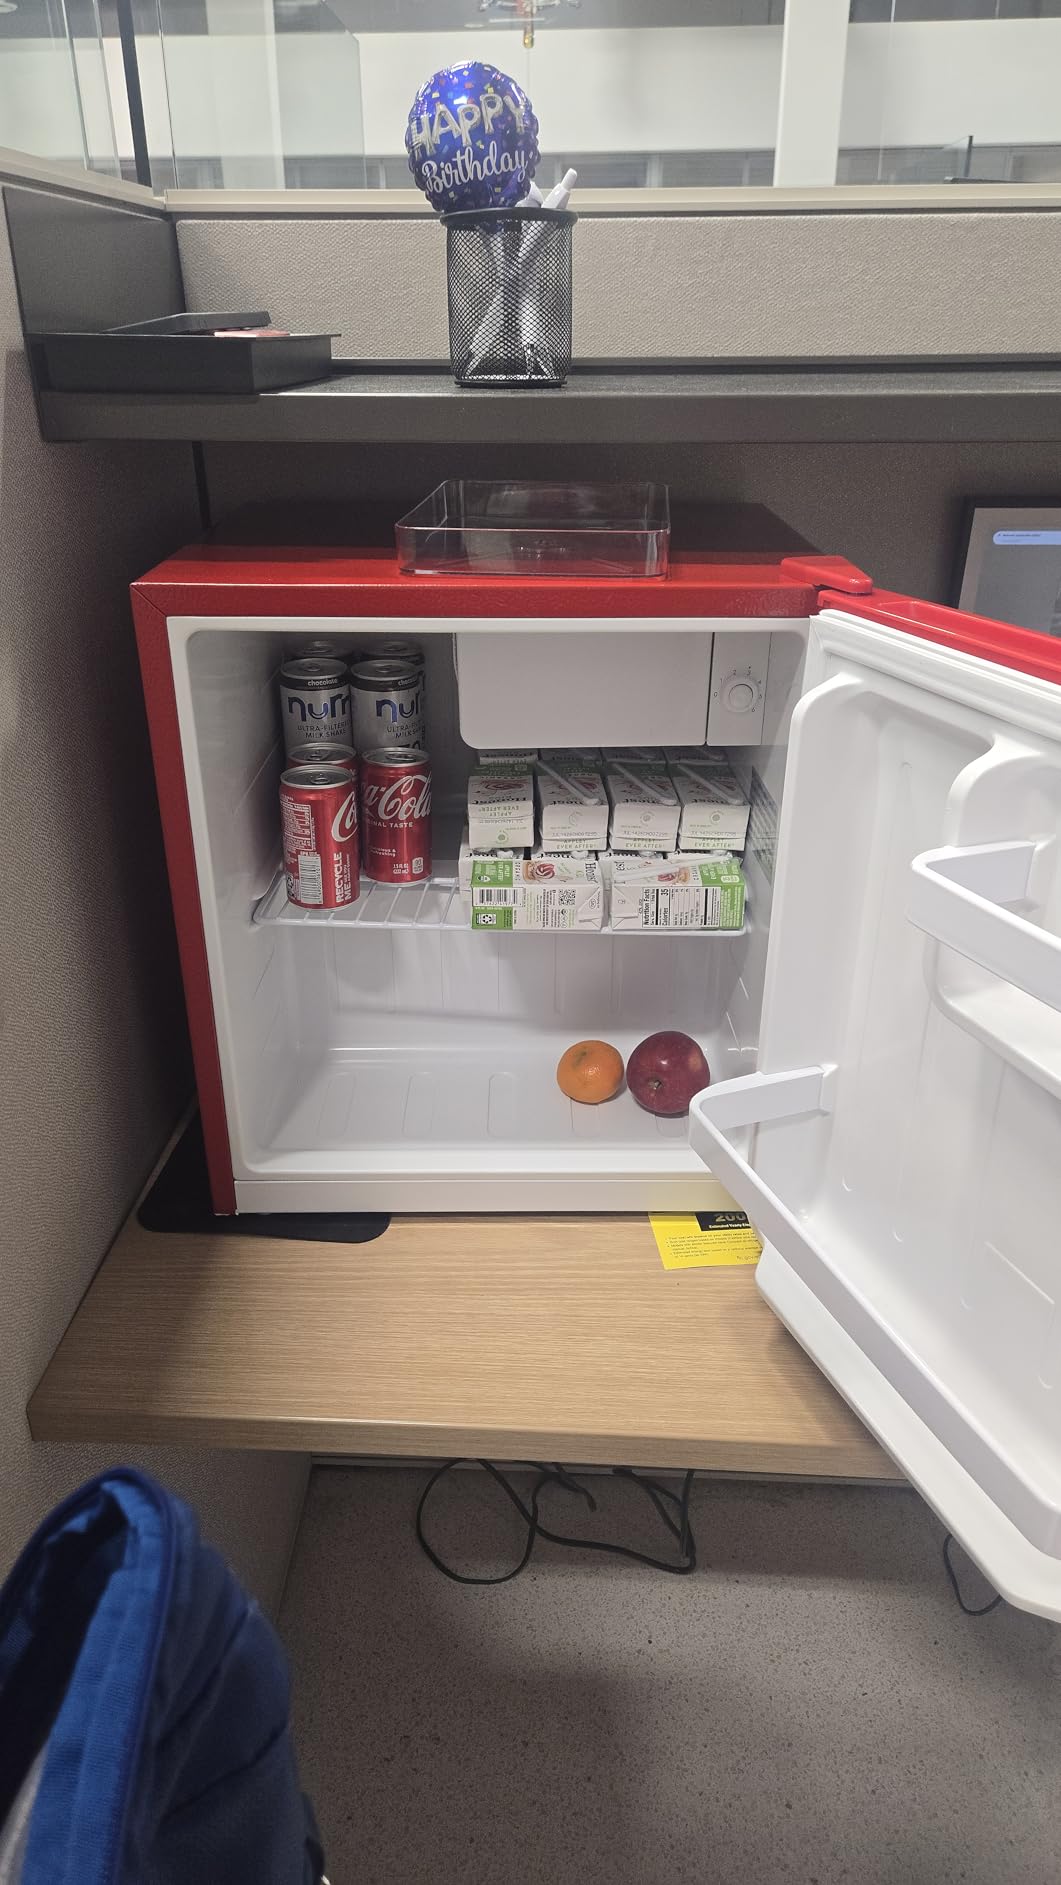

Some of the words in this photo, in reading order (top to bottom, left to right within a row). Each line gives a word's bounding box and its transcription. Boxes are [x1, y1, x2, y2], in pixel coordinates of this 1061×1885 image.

[410, 93, 527, 159] HAPPY
[421, 141, 529, 193] Birthday
[308, 678, 338, 686] chocolate
[334, 852, 344, 903] RECYCLE
[344, 882, 351, 900] ME
